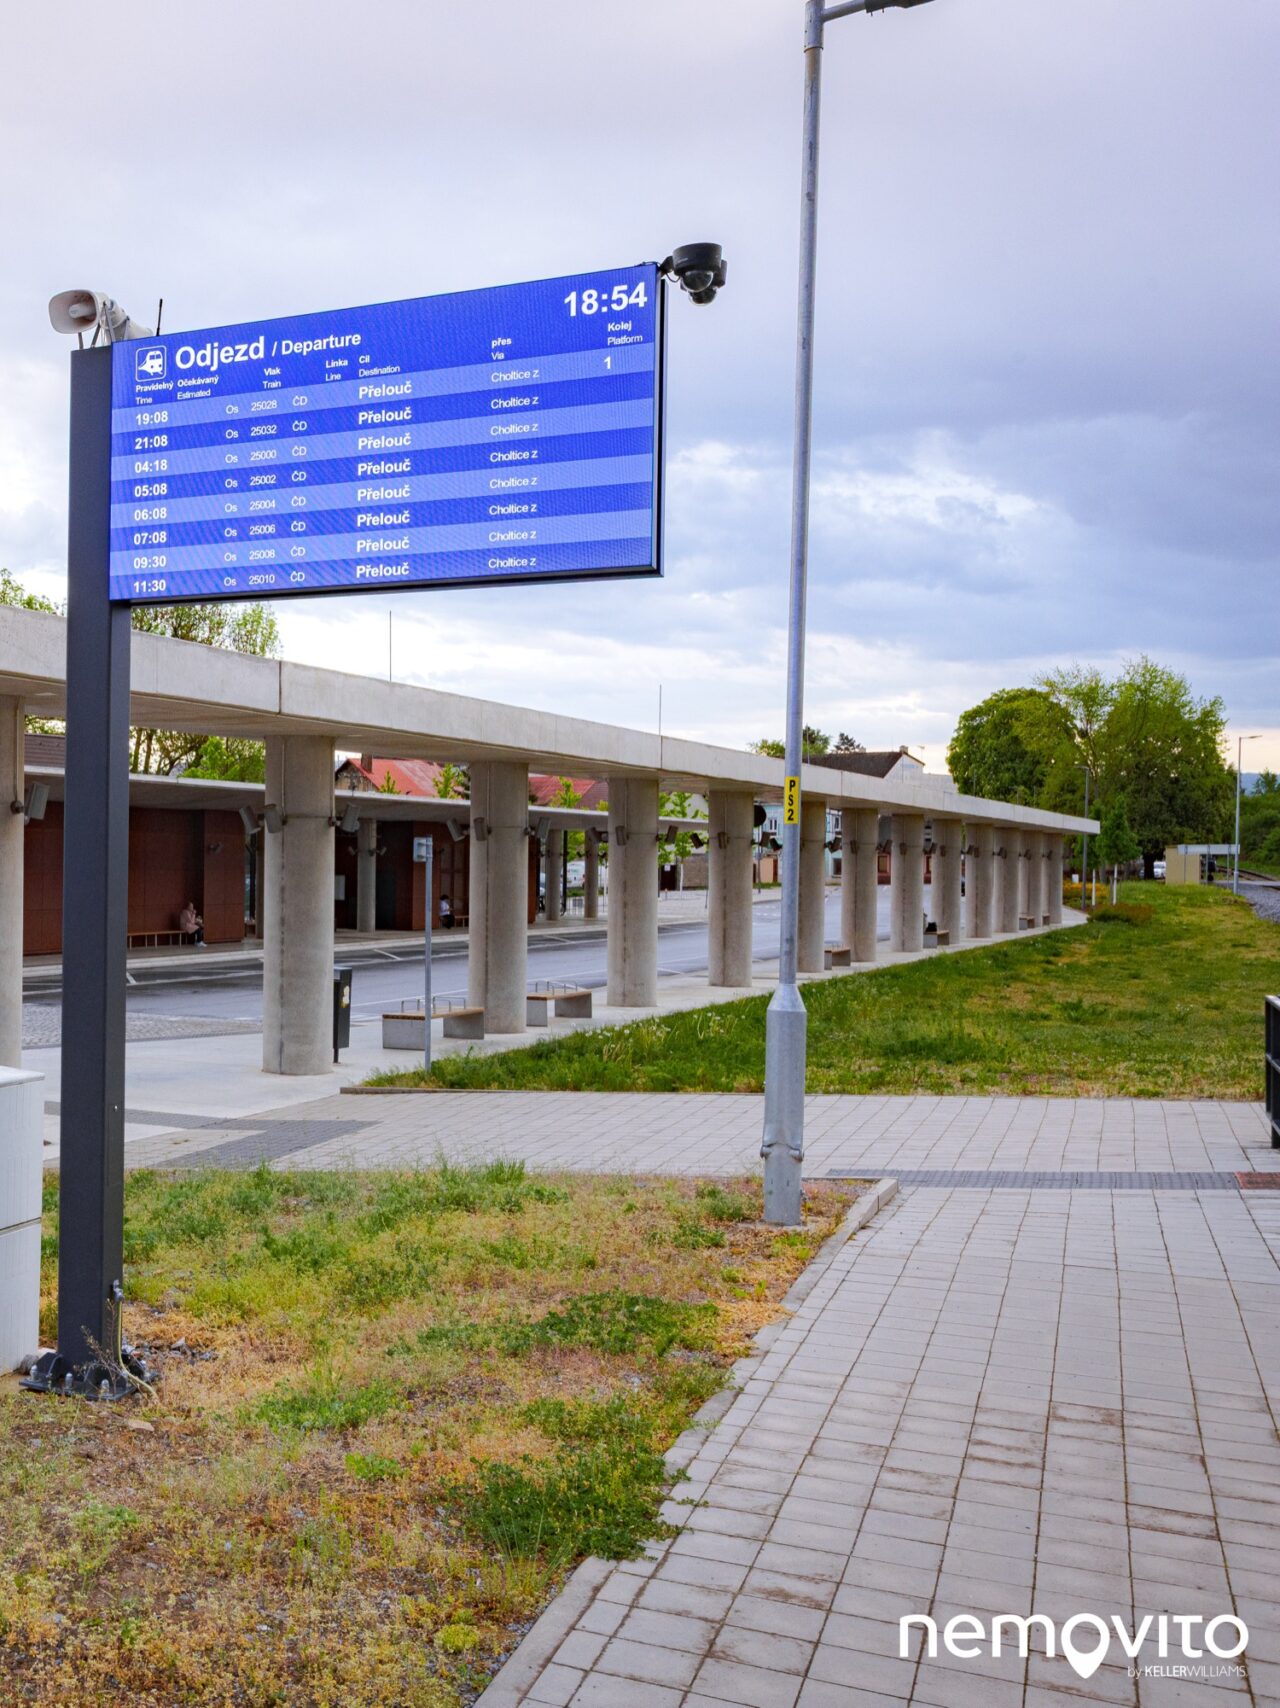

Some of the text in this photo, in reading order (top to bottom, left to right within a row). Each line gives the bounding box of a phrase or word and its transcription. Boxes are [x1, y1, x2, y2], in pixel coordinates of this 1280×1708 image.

[565, 282, 647, 316] 18:54
[608, 321, 631, 331] Kolej
[492, 338, 511, 348] přes
[608, 335, 643, 345] Platform
[176, 336, 264, 373] Odjezd
[282, 334, 361, 355] Departure
[326, 359, 348, 368] Linka
[491, 352, 504, 360] Via
[264, 367, 280, 375] Vlak
[326, 373, 341, 381] Line
[359, 366, 401, 378] Destination
[136, 379, 173, 392] Pravidelný
[136, 411, 168, 425] 19:08
[226, 405, 238, 414] Os
[251, 400, 277, 411] 25028
[293, 396, 307, 406] ČD
[359, 381, 411, 399] Přelouč
[492, 371, 530, 382] Choltice
[604, 357, 610, 369] 1
[177, 389, 210, 401] Estimated
[135, 435, 168, 449] 21:08
[226, 429, 238, 438] Os
[251, 425, 276, 436] 25032
[292, 421, 307, 431] ČD
[359, 407, 411, 424] Přelouč
[491, 397, 530, 409] Choltice
[135, 460, 167, 473] 04:18
[225, 455, 238, 463] Os
[250, 450, 276, 460] 25000
[292, 446, 306, 456] ČD
[359, 433, 411, 450] Přelouč
[491, 424, 529, 435] Choltice
[135, 483, 167, 497] 05:08
[225, 479, 237, 488] Os
[250, 475, 276, 485] 25002
[292, 471, 306, 481] ČD
[358, 459, 410, 475] Přelouč
[490, 451, 529, 462] Choltice
[135, 507, 167, 521] 06:08
[225, 503, 237, 512] Os
[250, 500, 275, 510] 25004
[291, 496, 306, 506] ČD
[358, 485, 410, 501] Přelouč
[490, 478, 529, 488] Choltice
[134, 531, 166, 544] 07:08
[225, 528, 237, 537] Os
[250, 524, 275, 535] 25006
[291, 521, 305, 531] ČD
[357, 511, 409, 527] Přelouč
[489, 504, 528, 515] Choltice
[134, 556, 166, 568] 09:30
[224, 552, 236, 561] Os
[249, 549, 275, 560] 25008
[291, 546, 305, 556] ČD
[357, 537, 409, 552] Přelouč
[489, 531, 528, 541] Choltice
[134, 580, 166, 592] 11:30
[224, 577, 236, 586] Os
[249, 574, 275, 584] 25010
[290, 572, 305, 582] ČD
[357, 562, 409, 578] Přelouč
[488, 558, 527, 568] Choltice
